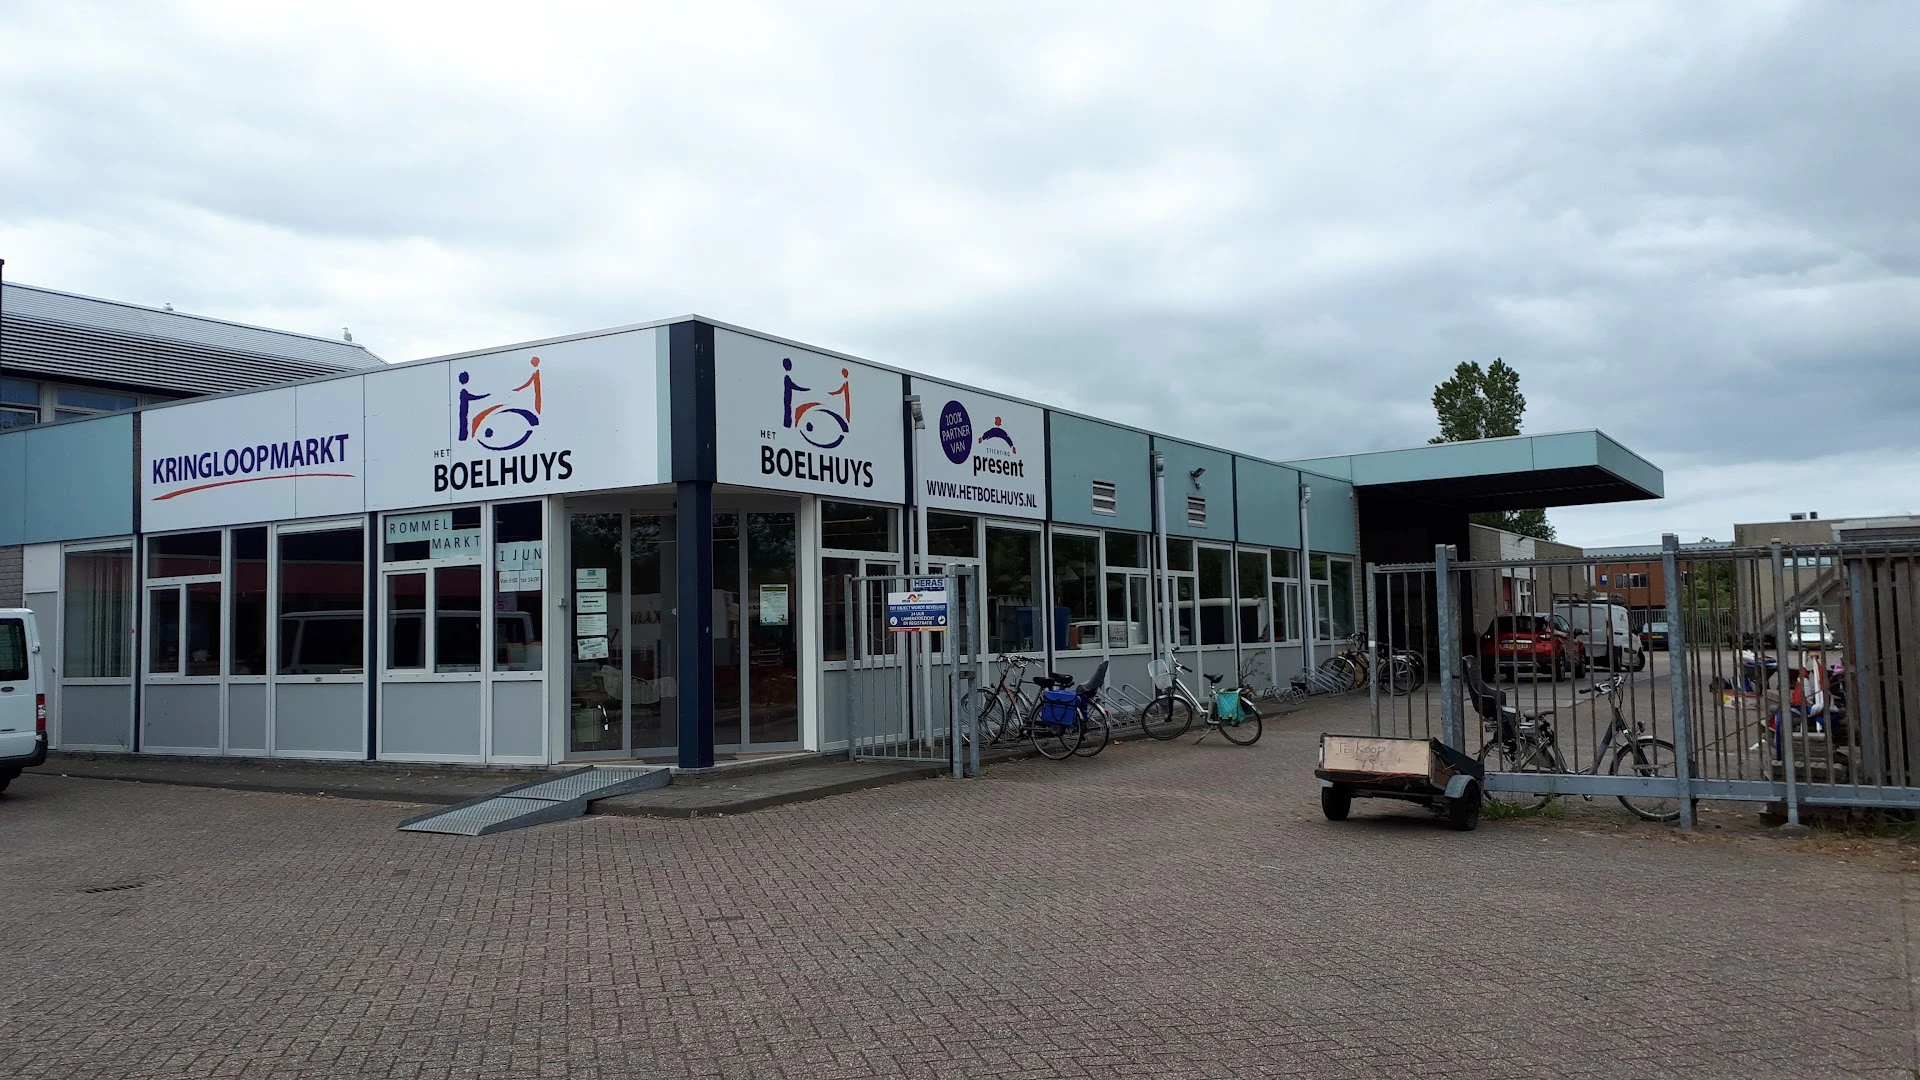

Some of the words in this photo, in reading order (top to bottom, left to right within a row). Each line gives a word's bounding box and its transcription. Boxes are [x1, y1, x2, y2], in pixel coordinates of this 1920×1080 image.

[944, 411, 963, 426] 100%
[760, 429, 777, 440] HET
[941, 424, 971, 442] PARTNER
[433, 448, 451, 459] HET
[950, 440, 966, 454] VAN
[986, 447, 1011, 457] STICHTING
[152, 433, 350, 485] KRINGLOOPMARKT
[761, 445, 874, 488] BOELHUYS
[973, 455, 1024, 478] present
[434, 450, 573, 492] BOELHUYS
[926, 479, 1038, 508] WWW.HETBOELHUYS.NL
[389, 518, 449, 535] ROMMEL
[431, 535, 481, 551] MARKT
[499, 550, 505, 562] 1
[914, 579, 944, 587] HERAS
